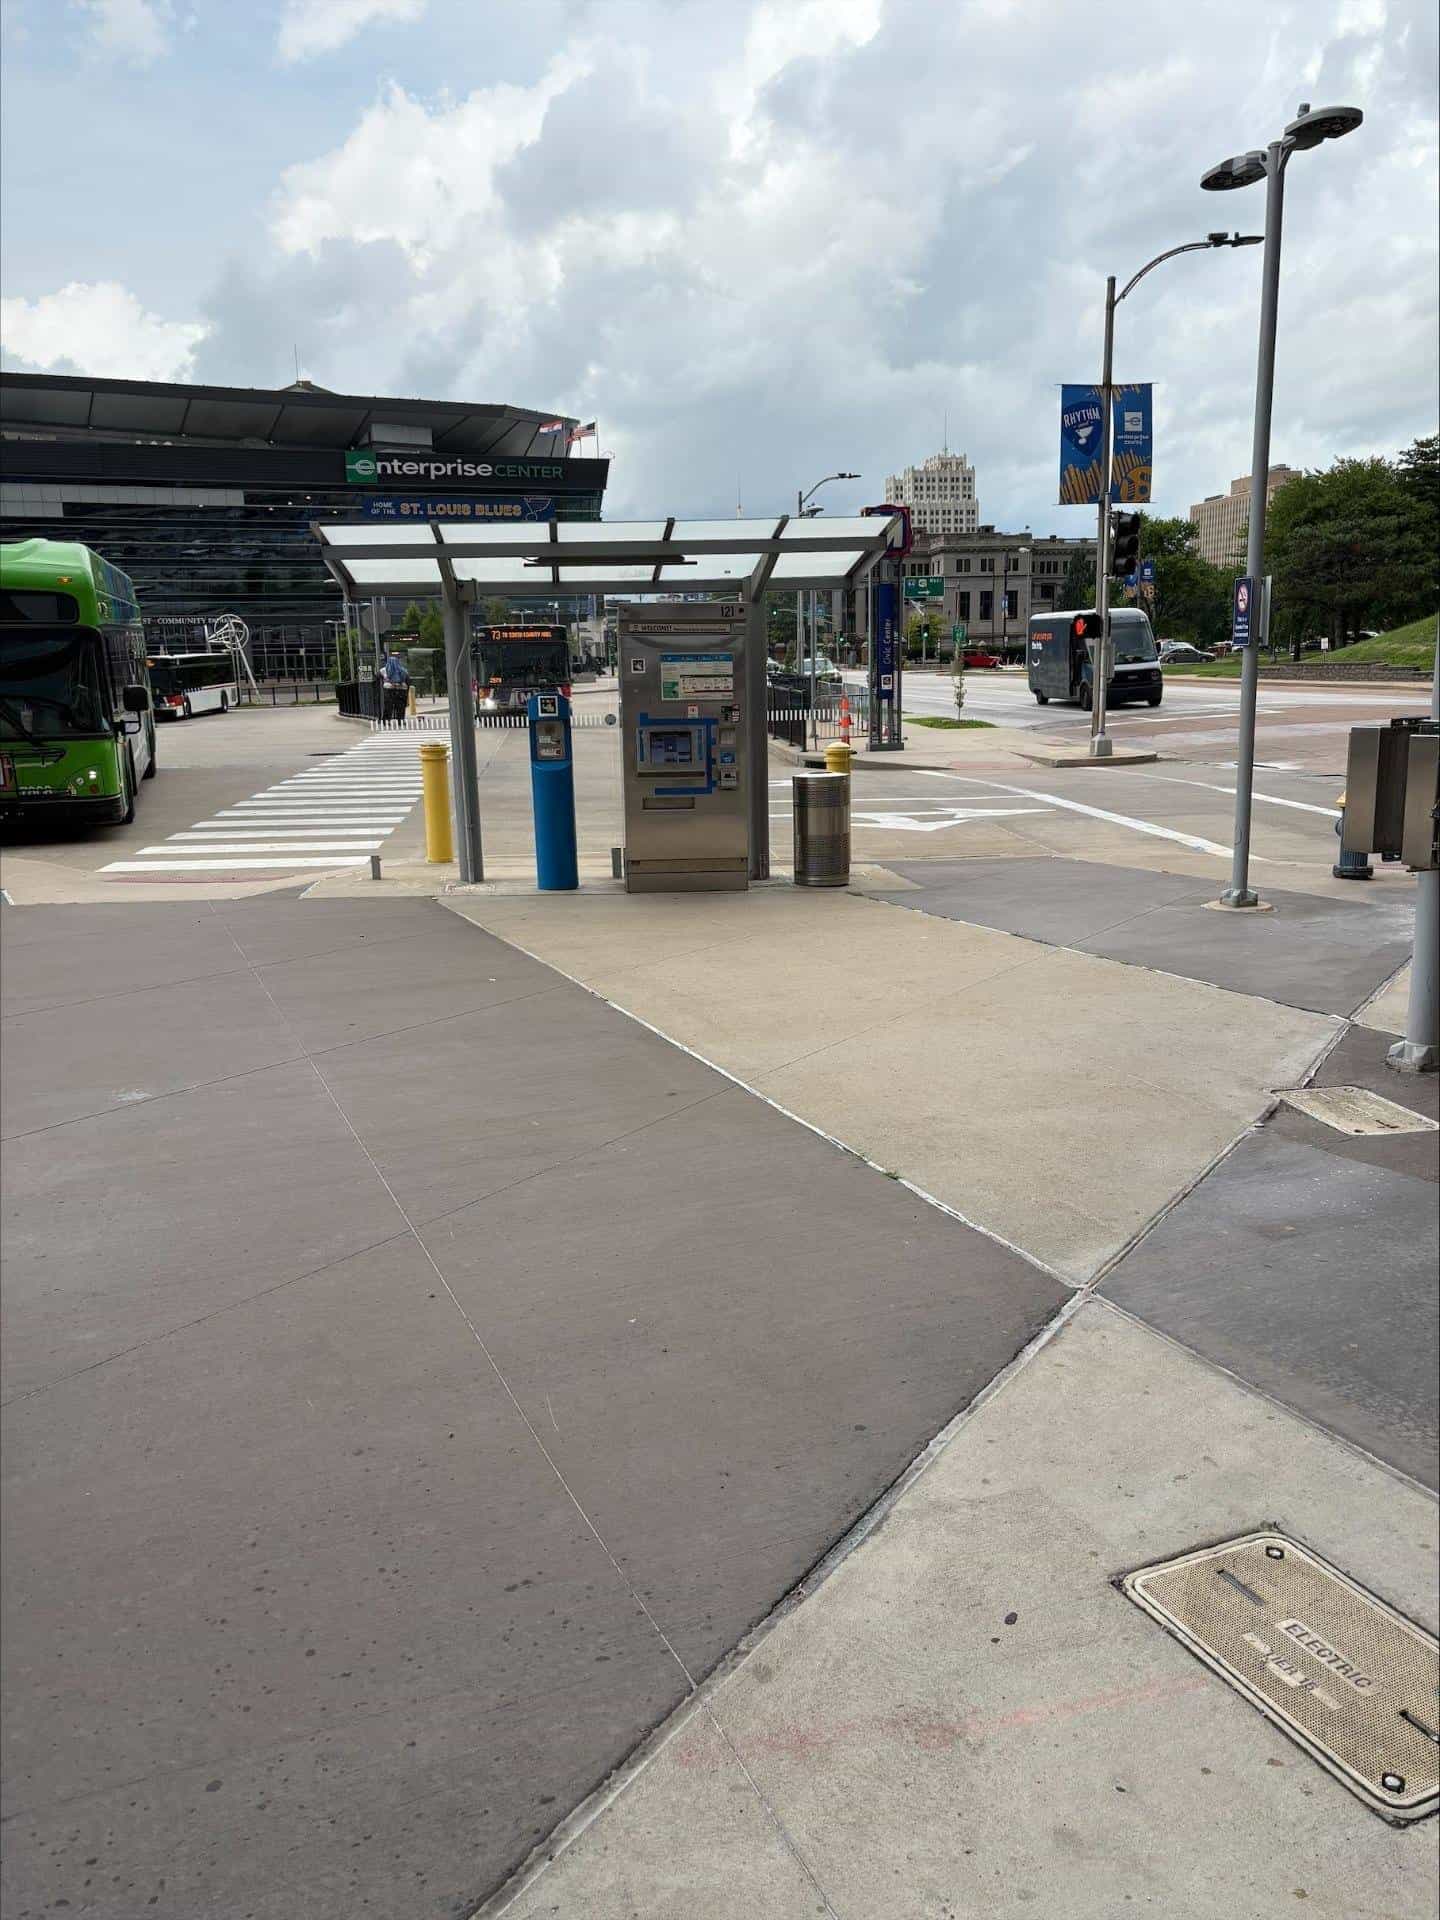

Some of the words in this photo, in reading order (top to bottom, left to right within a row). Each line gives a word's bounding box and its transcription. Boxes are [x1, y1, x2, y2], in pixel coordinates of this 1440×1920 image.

[1063, 407, 1101, 428] RHYTHM
[350, 458, 493, 480] enterprise
[495, 464, 563, 479] CENTER
[399, 502, 424, 515] ST.
[427, 503, 472, 516] LOUIS
[475, 504, 522, 517] BLUES
[720, 605, 735, 617] 121
[157, 617, 206, 625] COMMUNITY
[491, 630, 501, 640] 73
[1284, 1623, 1373, 1688] ELECTRIC
